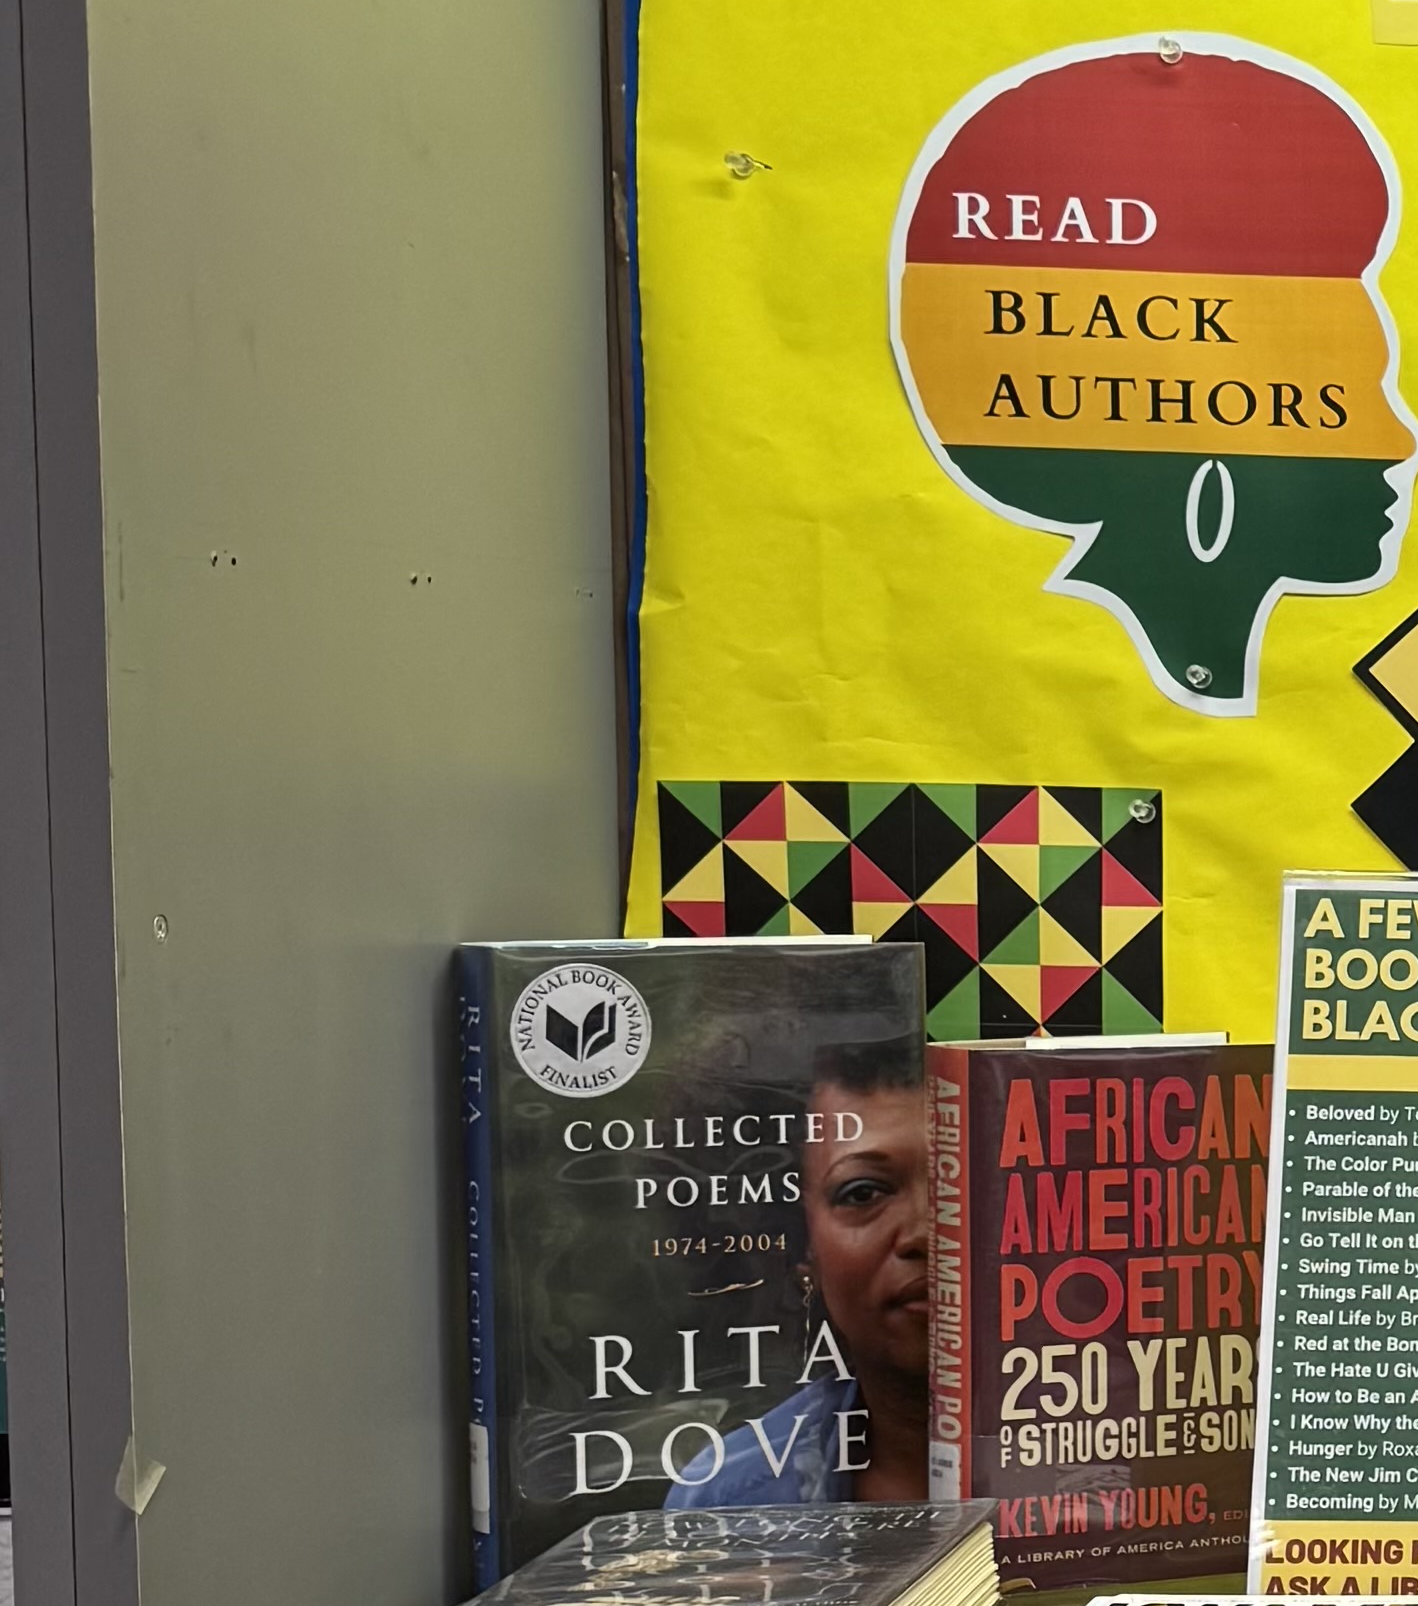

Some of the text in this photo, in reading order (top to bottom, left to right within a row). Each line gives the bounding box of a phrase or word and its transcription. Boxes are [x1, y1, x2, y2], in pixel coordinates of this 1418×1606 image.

[952, 193, 1157, 244] READ
[984, 290, 1238, 343] BLACK
[984, 374, 1347, 429] AUTHORS
[1304, 898, 1345, 938] A
[518, 970, 642, 1056] NATIONAL BOOK AWARD
[540, 1064, 618, 1089] FINALIST
[564, 1112, 869, 1152] COLLECTED
[1306, 1105, 1375, 1120] Beloved
[1380, 1106, 1399, 1125] by
[1304, 1155, 1336, 1171] The
[1341, 1156, 1388, 1171] Color
[635, 1172, 800, 1208] POEMS
[654, 1234, 785, 1256] 1974-2004
[589, 1320, 854, 1399] RITA
[1001, 1335, 1260, 1420] 250 YEAR
[570, 1410, 870, 1496] DOVE
[1265, 1539, 1403, 1564] LOOKING
